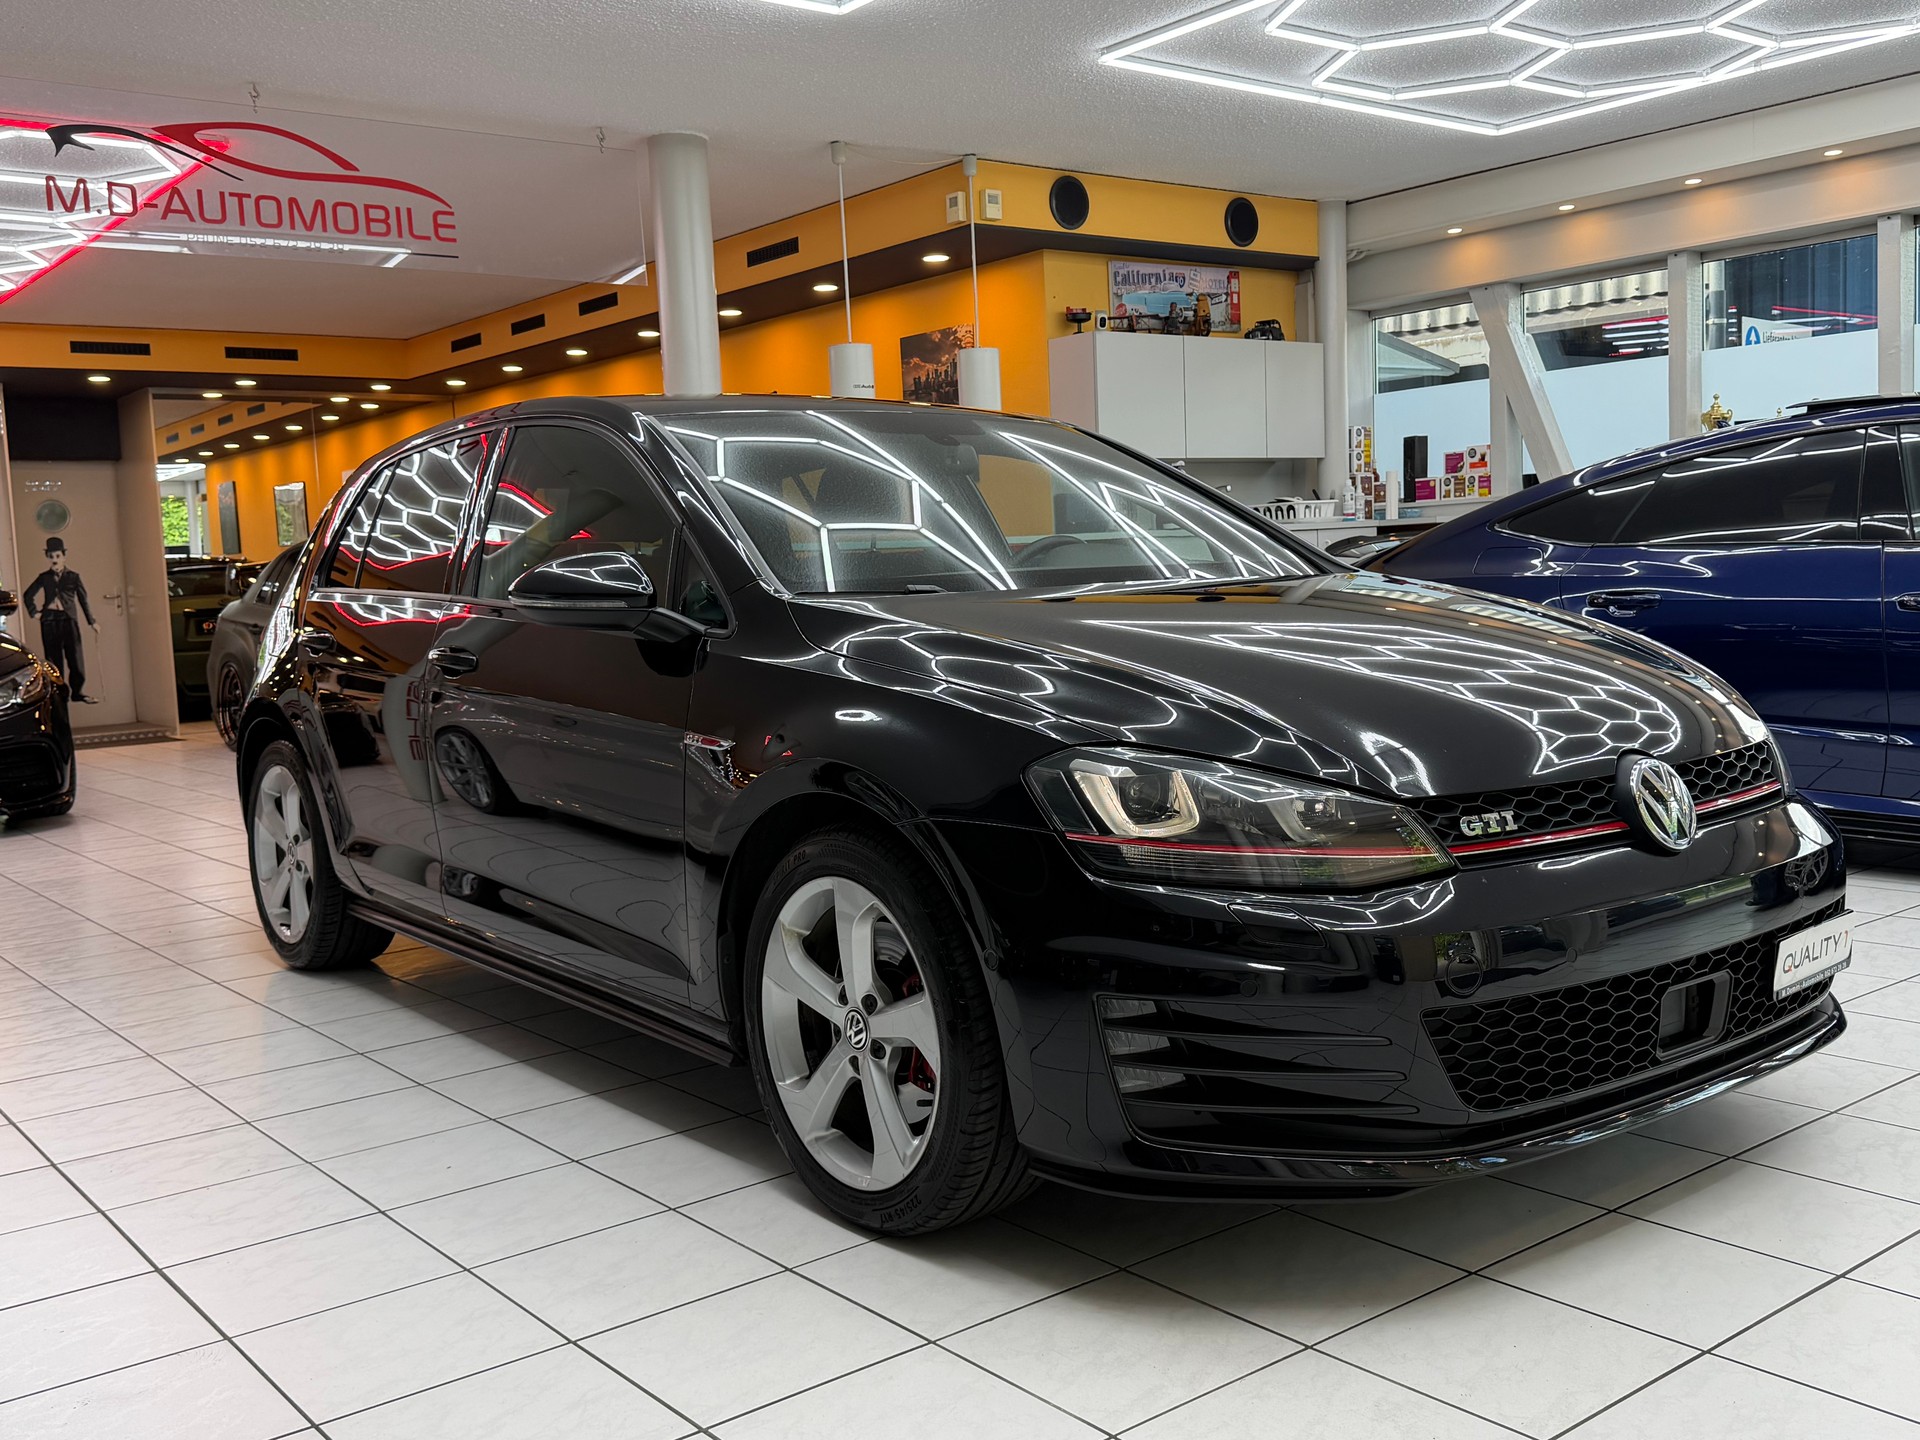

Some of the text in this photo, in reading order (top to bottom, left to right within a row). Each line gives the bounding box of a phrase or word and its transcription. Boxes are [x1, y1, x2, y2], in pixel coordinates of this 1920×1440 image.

[45, 175, 458, 243] M.D-AUTOMOBILE
[1113, 269, 1176, 287] California
[1460, 811, 1518, 836] GTI
[1782, 932, 1842, 974] QUALITY
